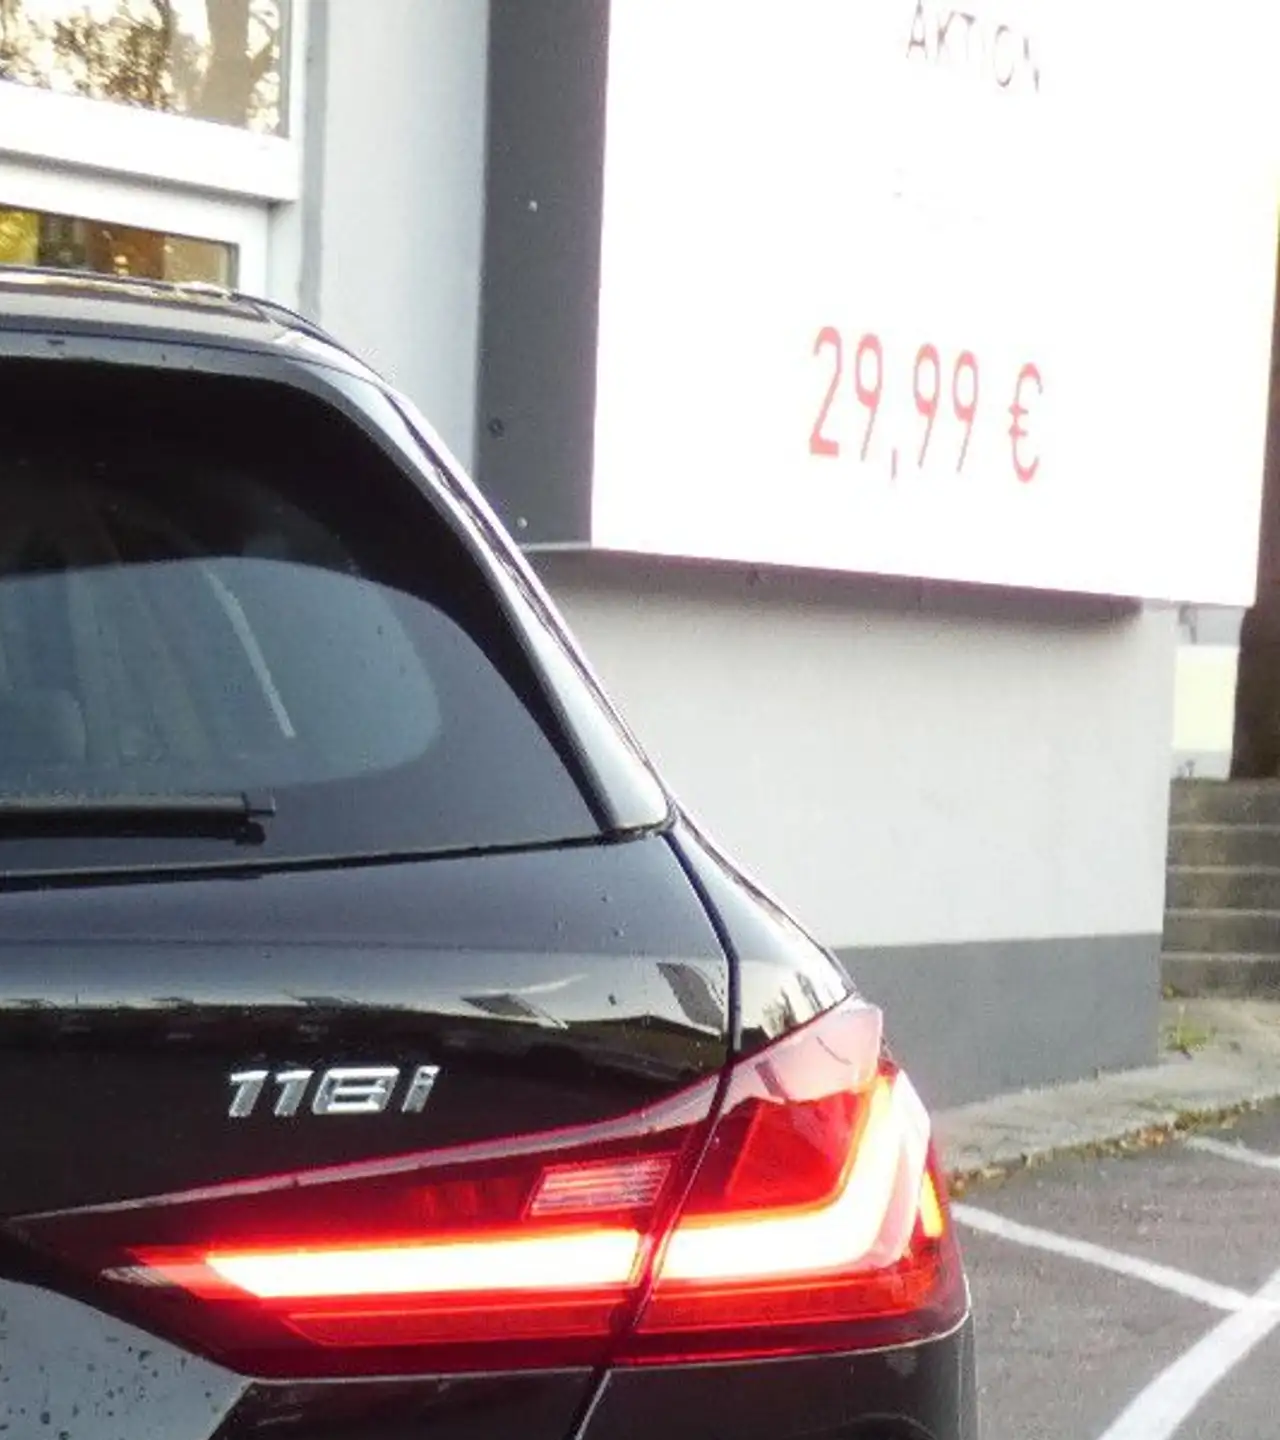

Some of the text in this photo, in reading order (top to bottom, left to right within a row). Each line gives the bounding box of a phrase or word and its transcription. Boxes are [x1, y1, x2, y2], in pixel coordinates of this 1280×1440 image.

[809, 325, 1043, 483] 29,99 €
[228, 1064, 440, 1118] 118i
